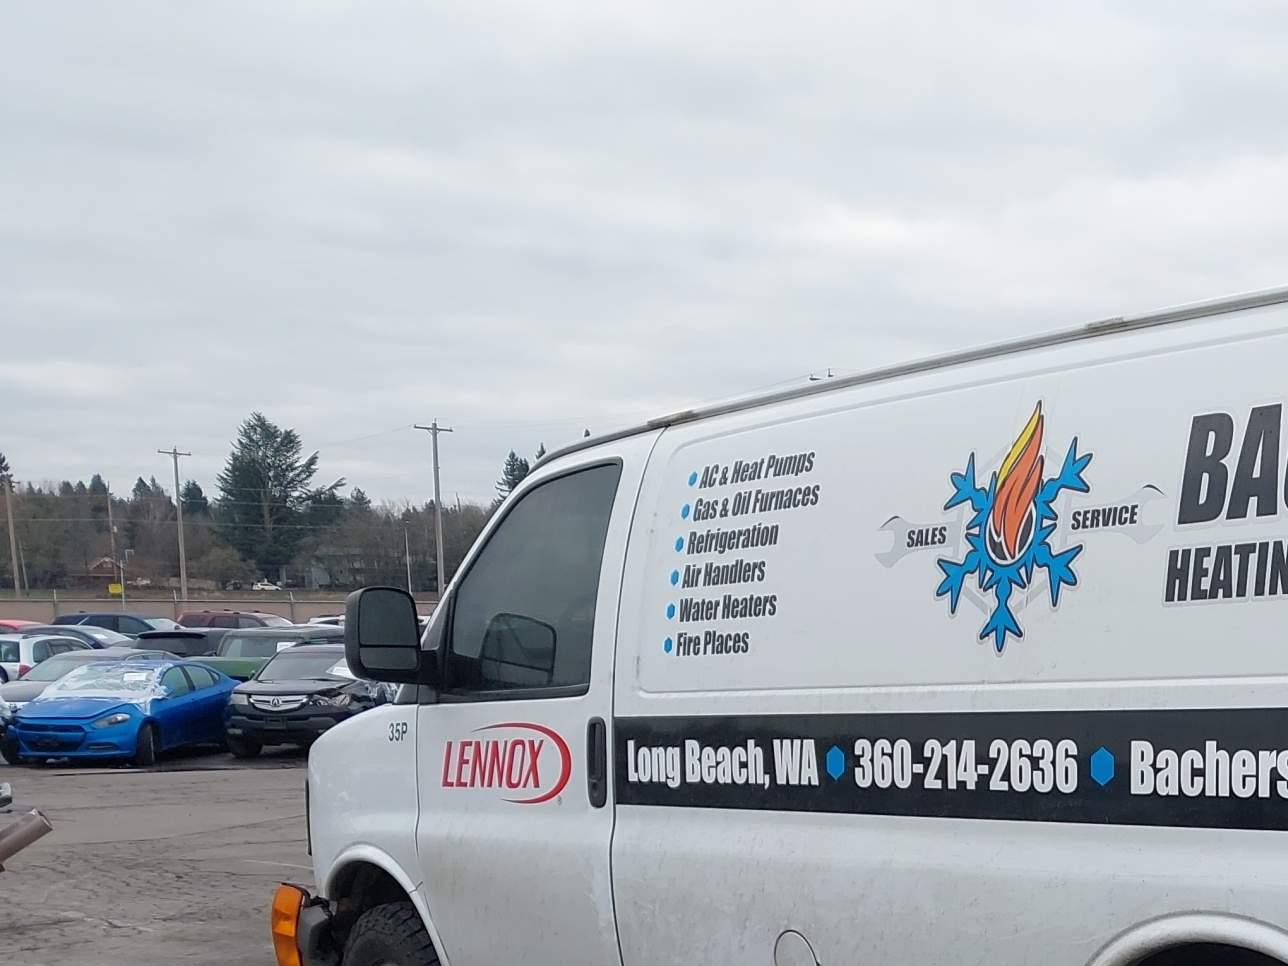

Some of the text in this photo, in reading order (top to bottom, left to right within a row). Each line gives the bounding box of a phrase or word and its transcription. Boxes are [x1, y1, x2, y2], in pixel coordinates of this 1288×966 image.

[699, 451, 815, 488] AC & Heat Pumps
[693, 485, 820, 522] Gas & Oil Furnaces
[1071, 504, 1139, 530] SERVICE
[687, 523, 779, 554] Refrigeration
[907, 527, 947, 548] SALES
[682, 559, 766, 589] Air Handlers
[679, 594, 777, 623] Water Heaters
[676, 630, 749, 656] Fire Places
[388, 722, 408, 742] 35P
[442, 739, 544, 789] LENNOX
[626, 739, 681, 787] Long
[684, 740, 771, 790] Beach,
[773, 739, 819, 787] WA
[854, 739, 1079, 793] 360-214-2636
